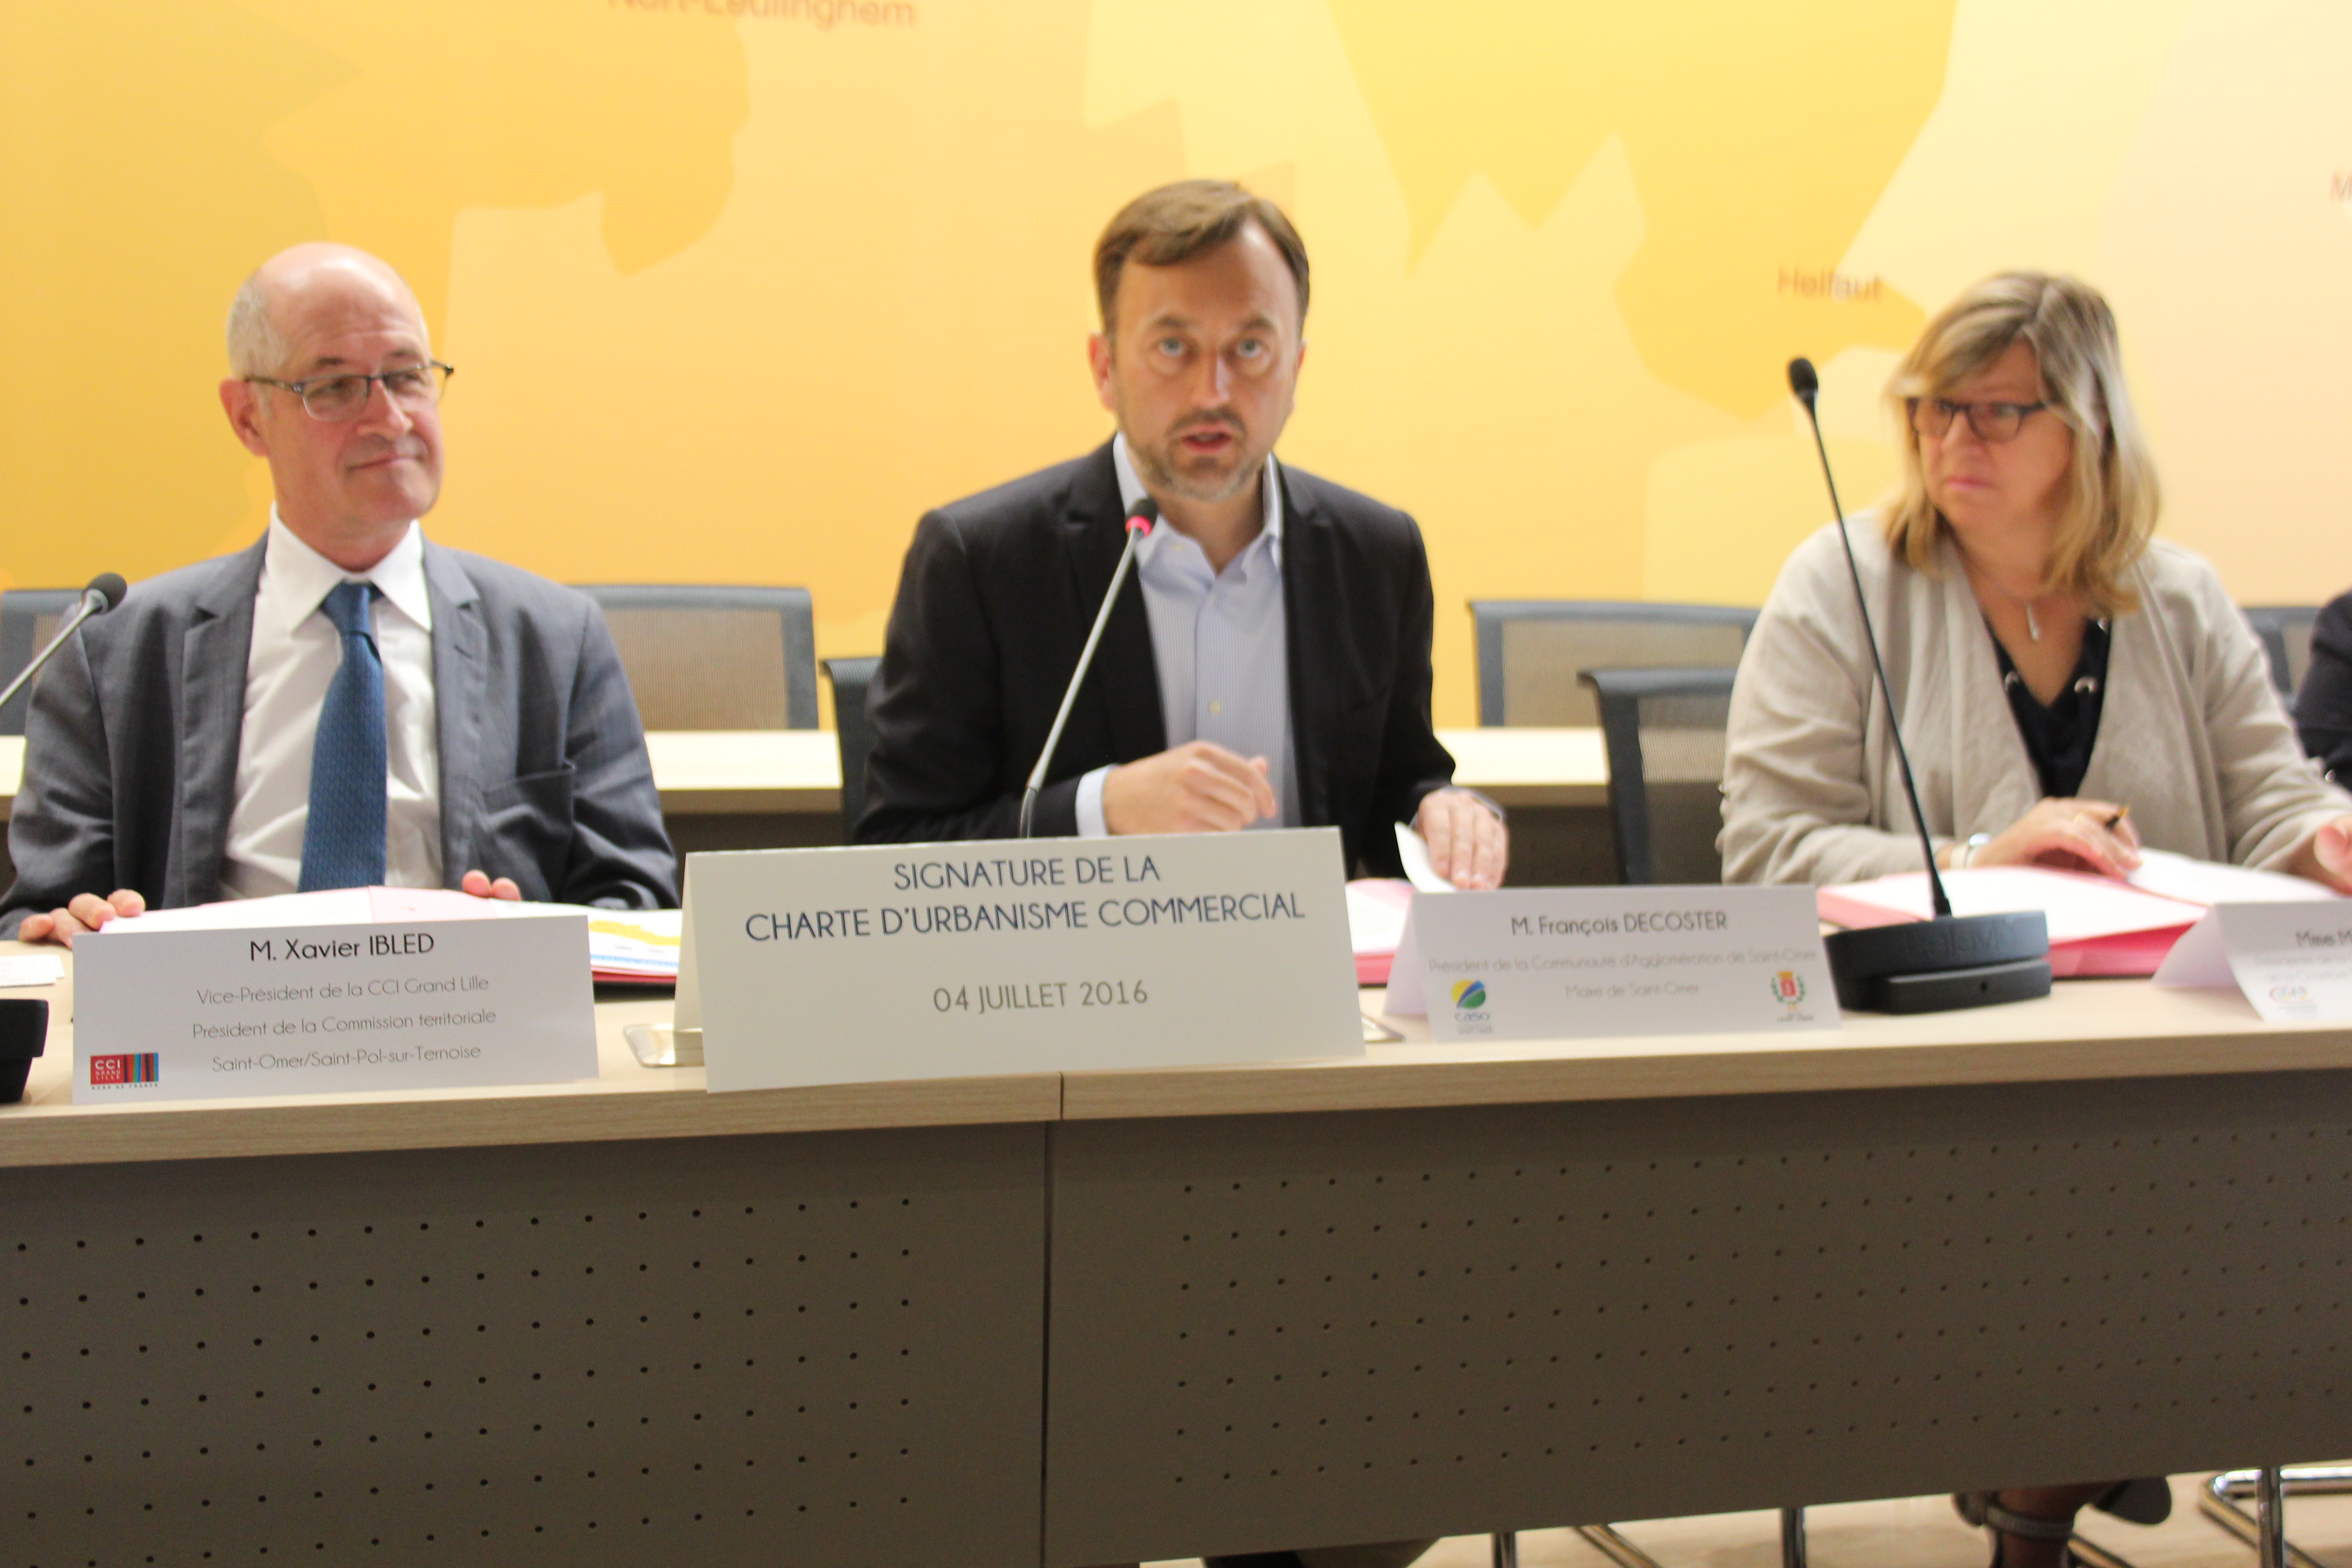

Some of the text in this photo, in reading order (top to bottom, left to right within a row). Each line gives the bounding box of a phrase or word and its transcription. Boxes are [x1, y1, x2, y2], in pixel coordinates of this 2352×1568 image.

[893, 855, 1161, 891] SIGNATURE DE LA
[745, 892, 1305, 941] CHARTE D'URBANISME COMMERCIAL
[1511, 911, 1727, 937] M. François DECOSTER
[250, 933, 434, 961] M. Xavier IBLED
[1428, 957, 1488, 973] Président
[1493, 958, 1511, 972] de
[1515, 957, 1529, 971] la
[1531, 955, 1615, 971] Communauté
[1727, 952, 1744, 965] de
[197, 975, 489, 1004] Vice-Président de la CCI Grand Lille
[933, 979, 1148, 1014] 04 JUILLET 2016
[1565, 984, 1603, 999] Maire
[1607, 984, 1625, 997] de
[193, 1008, 496, 1039] Président de la Commission territoriale
[95, 1059, 121, 1070] CCI
[212, 1045, 481, 1072] Saint-Omer/Saint-Pol-sur-Ternoise
